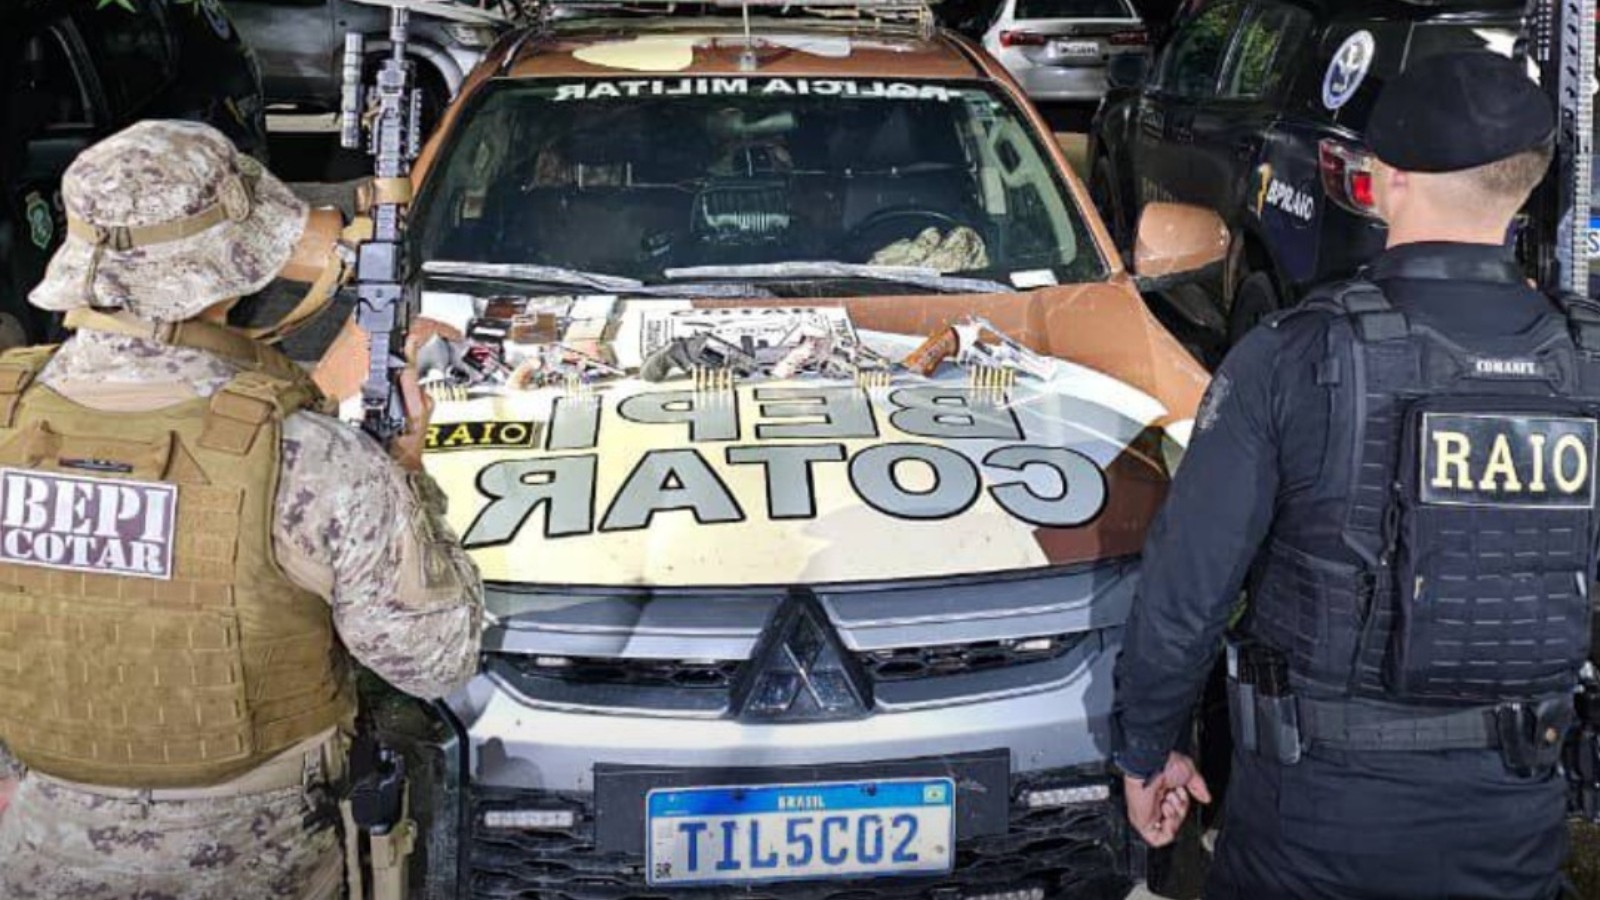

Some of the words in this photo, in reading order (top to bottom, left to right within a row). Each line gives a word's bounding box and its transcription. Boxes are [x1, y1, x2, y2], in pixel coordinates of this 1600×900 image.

[1431, 430, 1588, 493] RAIO
[3, 475, 170, 542] BEPI
[4, 528, 164, 574] COTAR
[777, 795, 826, 811] BRASIL
[678, 812, 919, 872] TIL5C02
